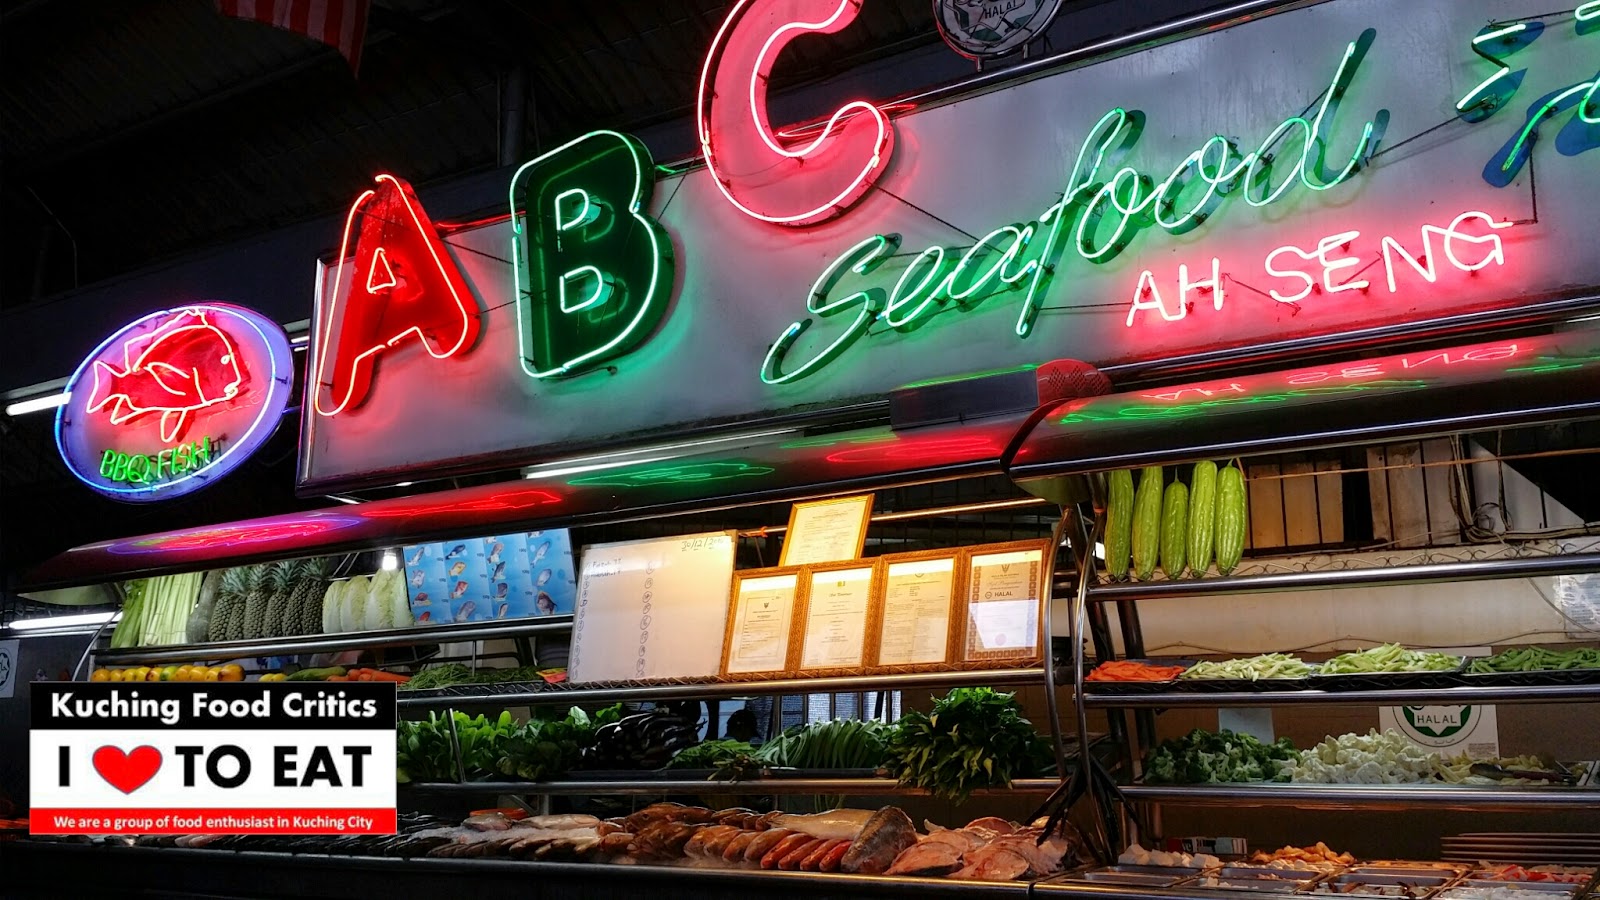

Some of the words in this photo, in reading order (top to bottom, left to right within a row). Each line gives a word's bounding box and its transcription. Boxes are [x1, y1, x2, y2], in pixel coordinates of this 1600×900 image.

[314, 0, 896, 417] ABC
[760, 28, 1390, 386] Seafood
[1126, 256, 1226, 327] AH
[1265, 210, 1513, 304] SENG
[99, 449, 151, 485] BBQ
[157, 435, 211, 479] FISH
[1417, 715, 1457, 724] HALAL
